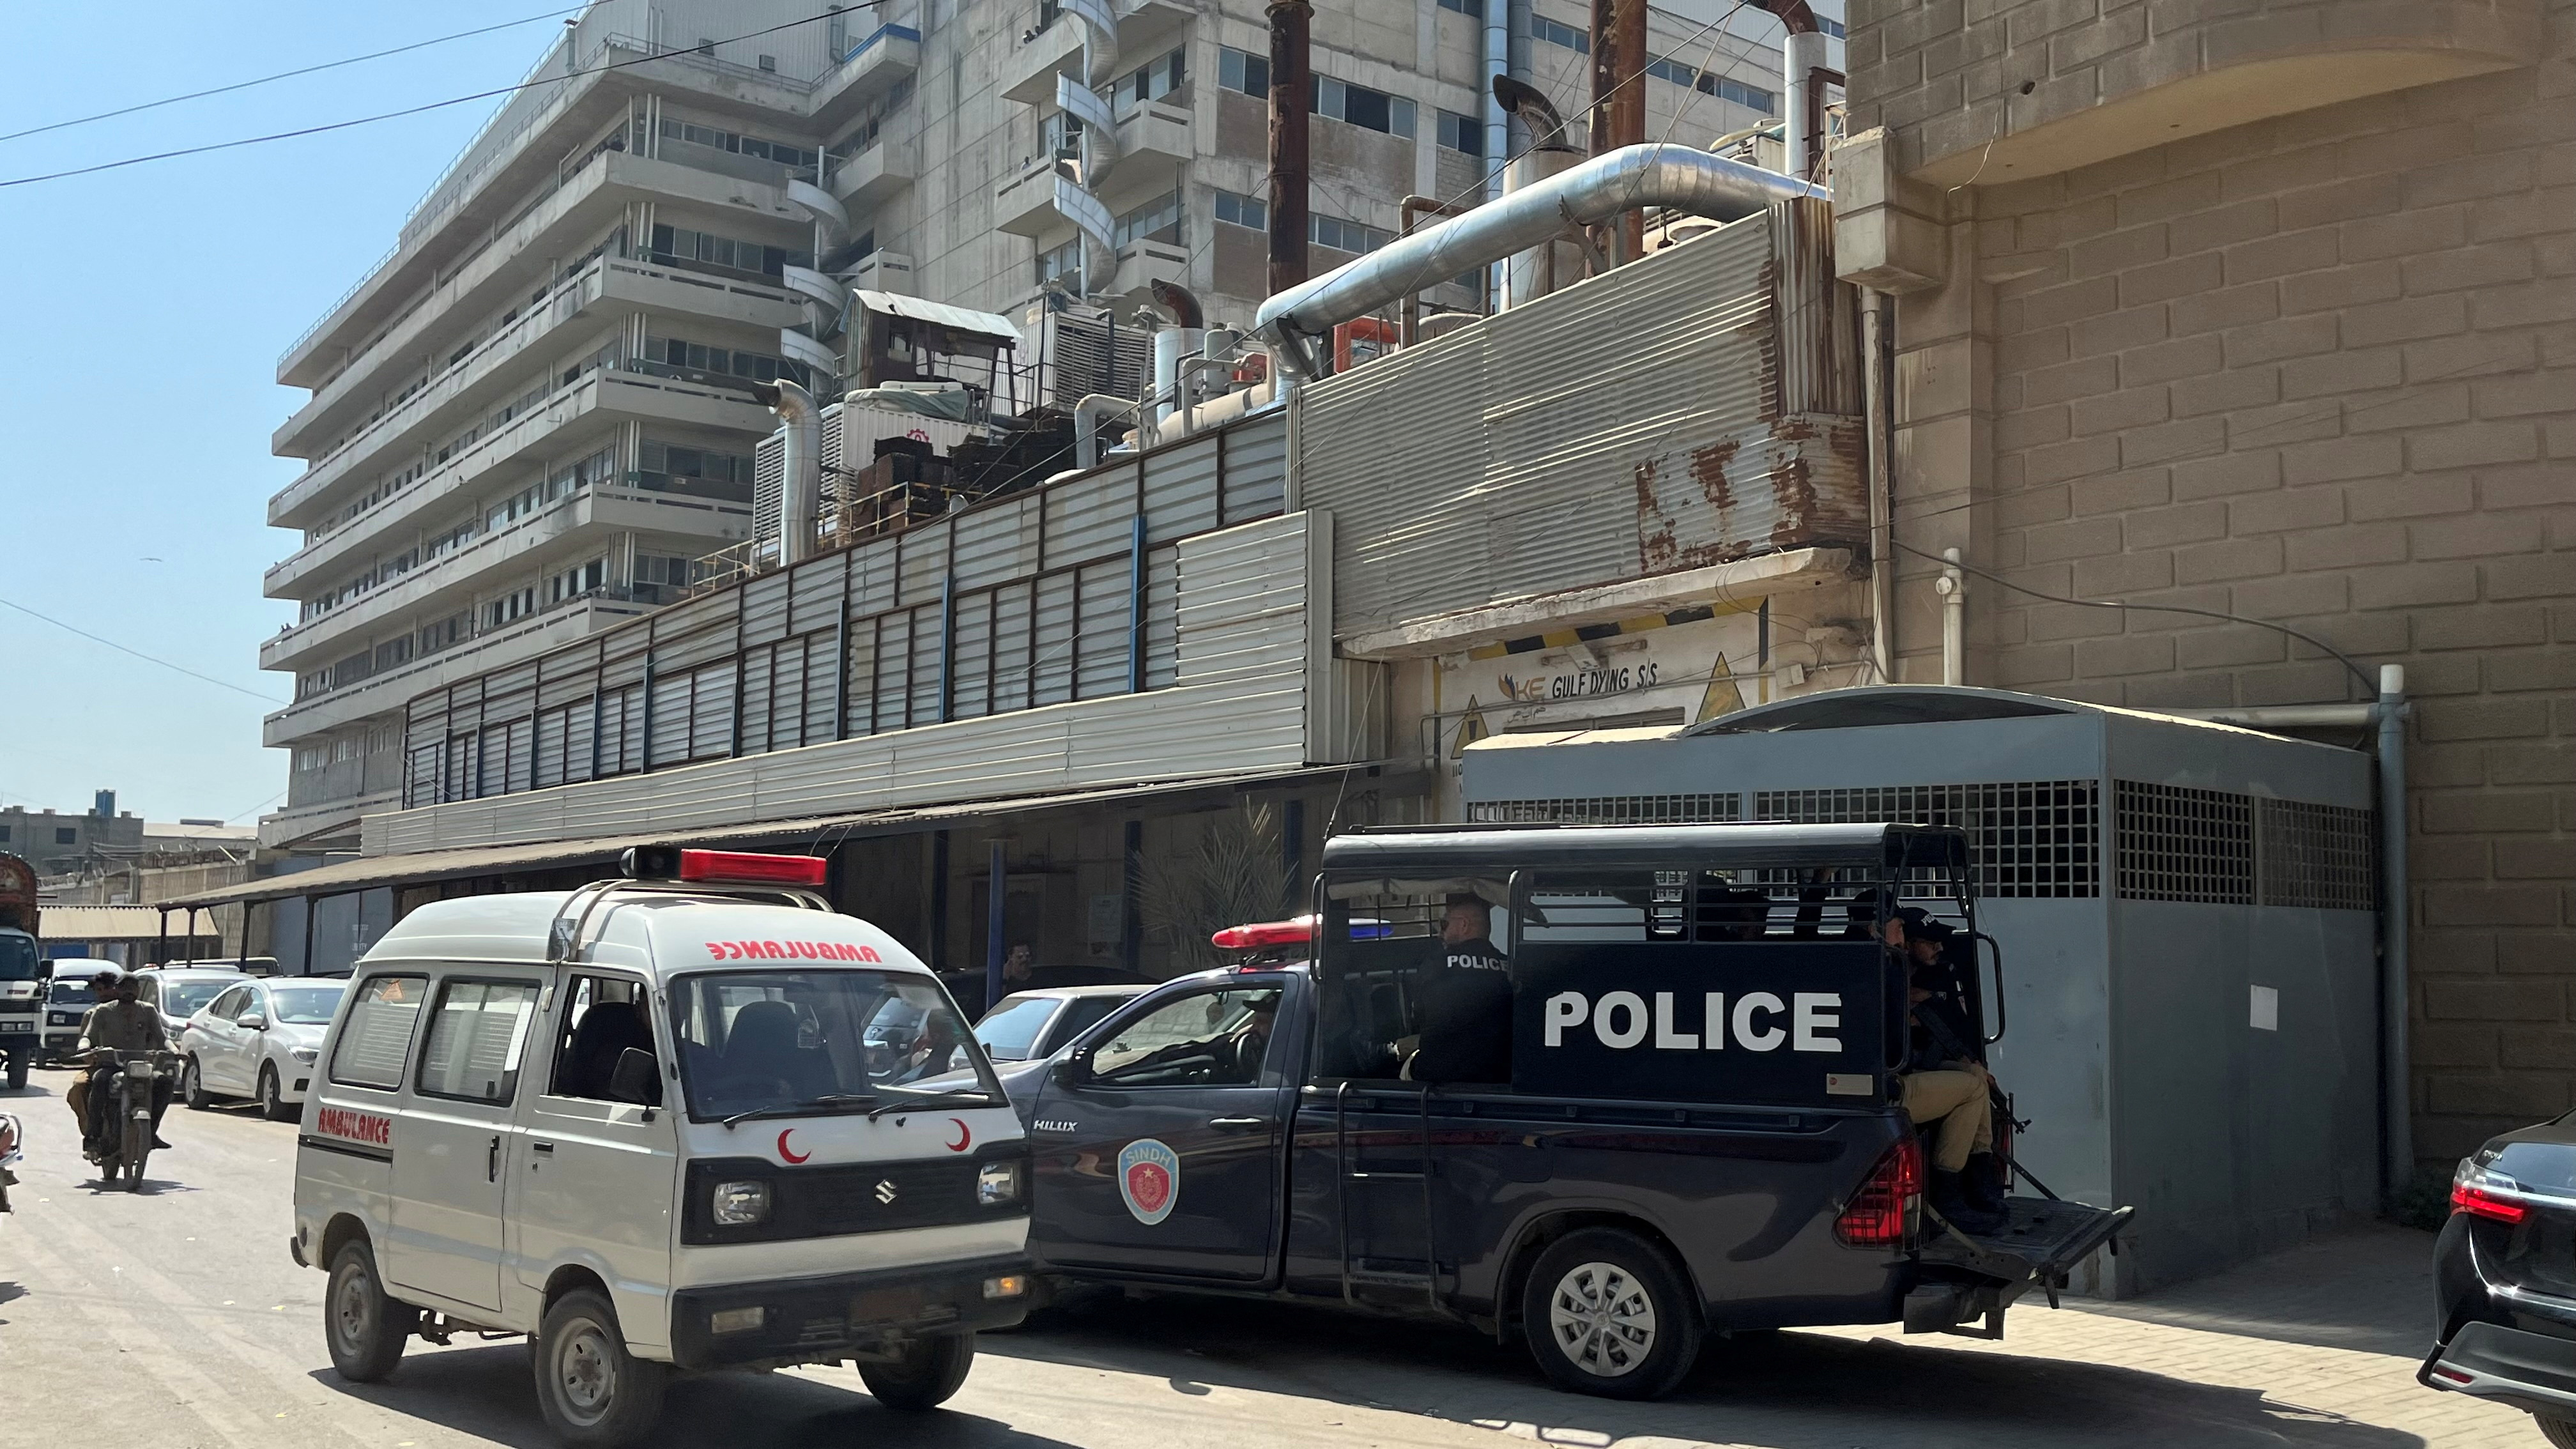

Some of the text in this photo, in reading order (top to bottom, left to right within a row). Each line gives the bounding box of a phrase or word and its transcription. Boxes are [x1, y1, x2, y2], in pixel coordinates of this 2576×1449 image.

[1515, 677, 1545, 700] KE
[1552, 672, 1586, 698] GULF
[1590, 668, 1629, 694] DYING
[1447, 954, 1508, 972] POLICE
[1545, 991, 1842, 1052] POLICE
[318, 1107, 390, 1144] AMBULANCE
[1034, 1119, 1078, 1131] HILUX
[1126, 1147, 1171, 1167] SINDH
